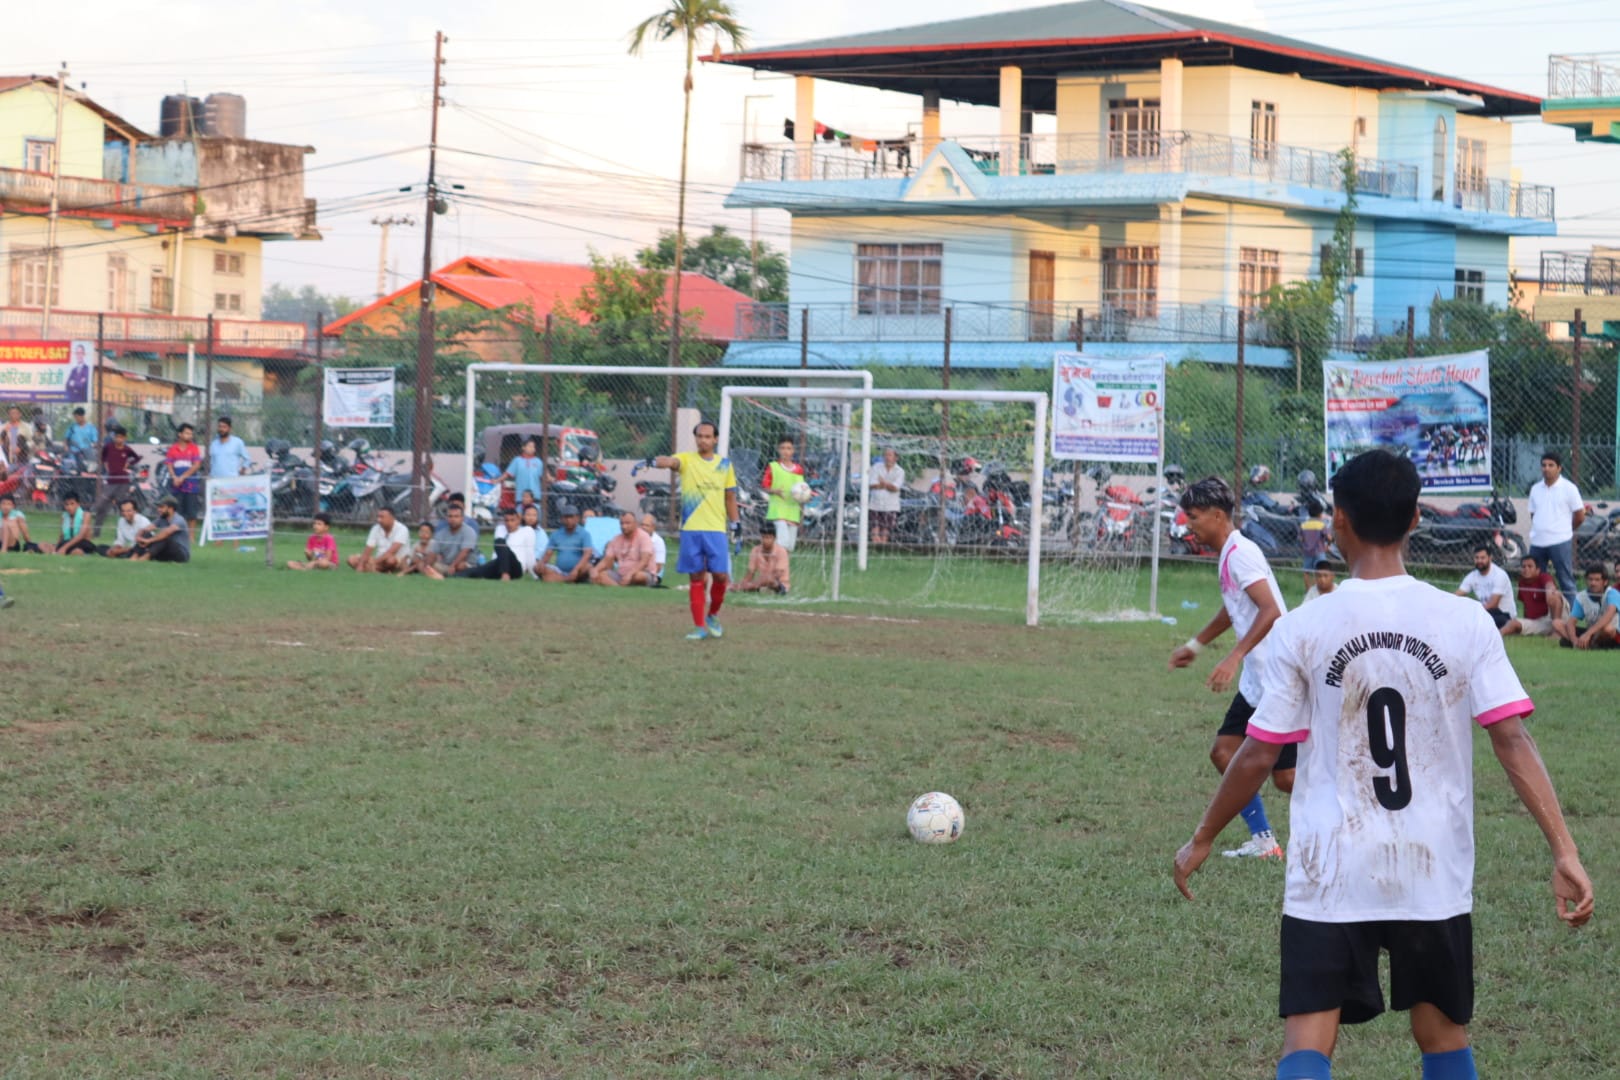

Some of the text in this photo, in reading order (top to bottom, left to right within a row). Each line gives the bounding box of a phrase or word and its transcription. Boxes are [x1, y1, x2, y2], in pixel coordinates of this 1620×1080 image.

[1445, 363, 1480, 382] House
[1325, 632, 1449, 688] PRAGATI KALA MANDIR YOUTH CLUB
[1366, 686, 1412, 811] 9
